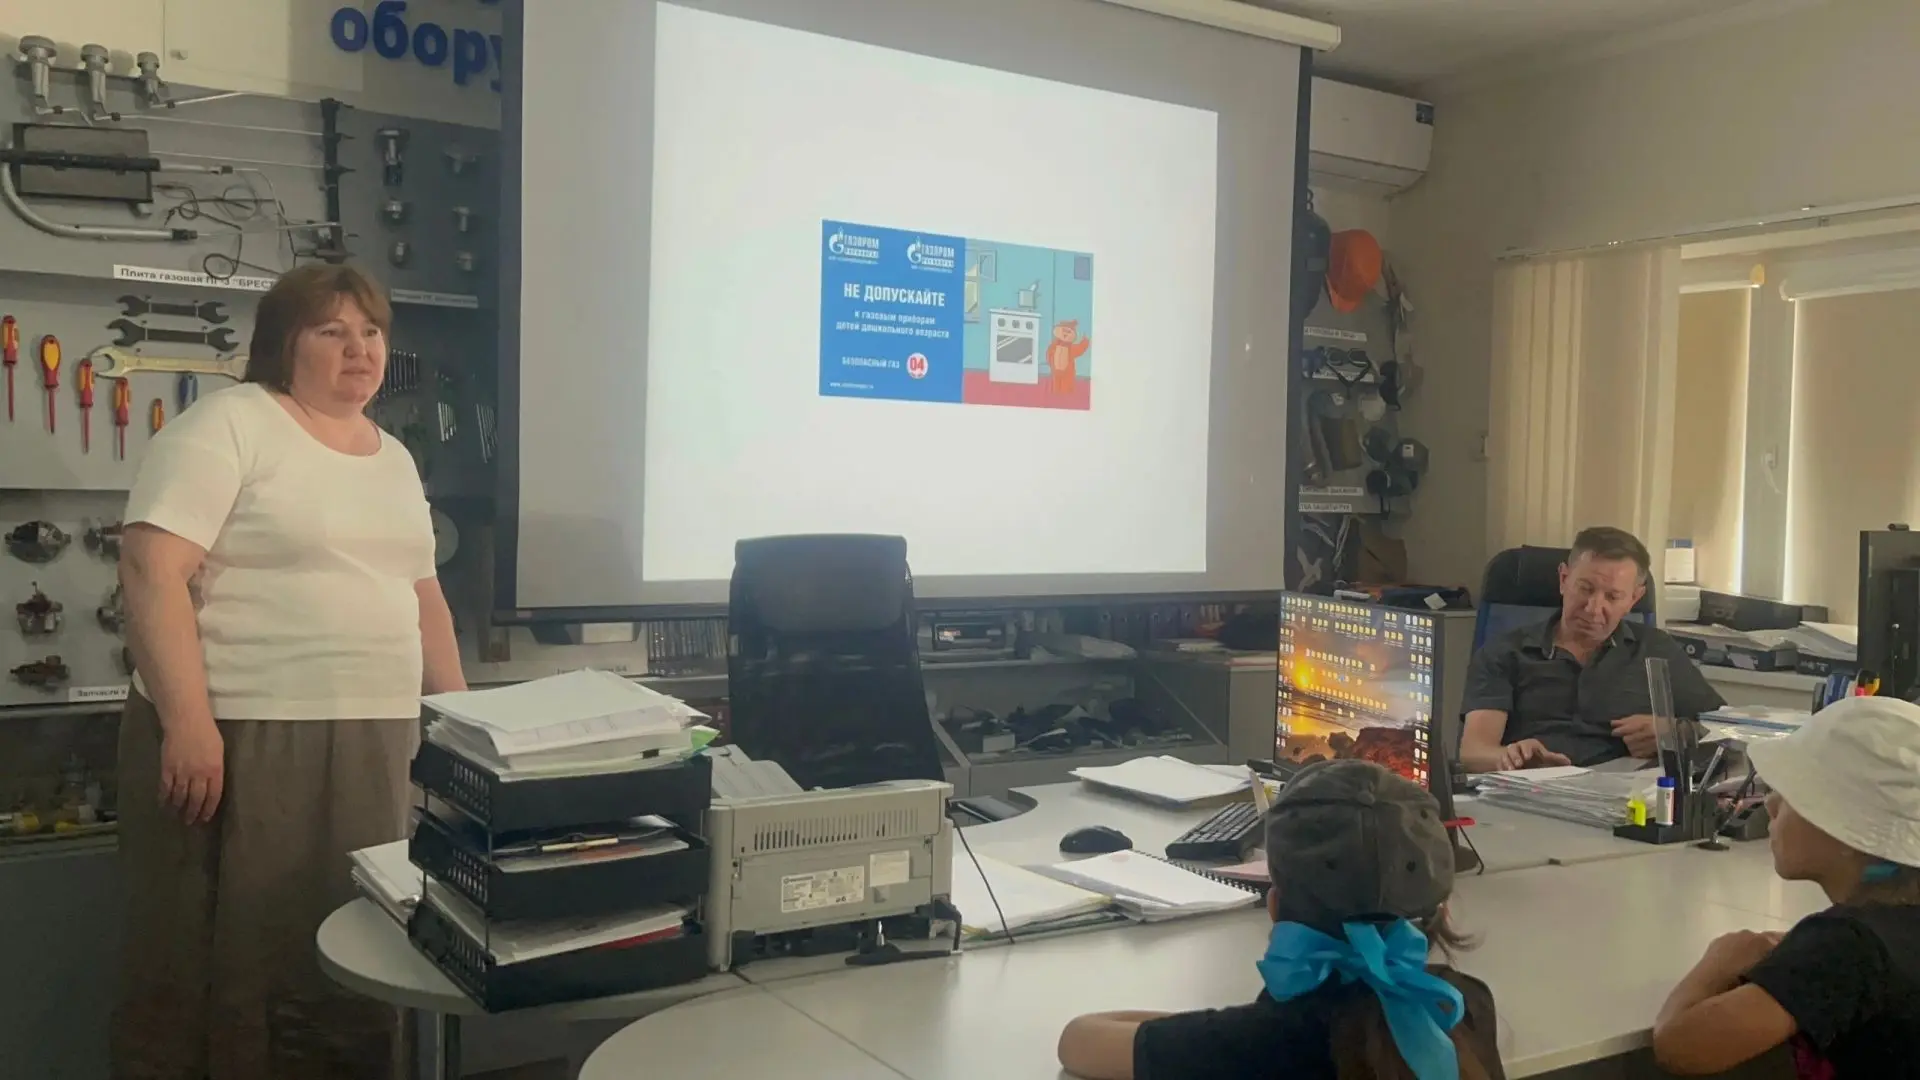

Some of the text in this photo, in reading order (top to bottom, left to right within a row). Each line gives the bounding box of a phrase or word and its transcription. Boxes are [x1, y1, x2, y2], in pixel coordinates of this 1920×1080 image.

[844, 234, 880, 250] ГАЗПРОМ
[921, 244, 955, 259] ГАЗПРОМ
[121, 267, 156, 279] Плита
[159, 273, 203, 284] газовая
[843, 282, 945, 307] НЕ ДОПУСКАЙТЕ
[862, 311, 896, 322] газовым
[898, 313, 936, 325] приборам
[836, 321, 950, 339] детей дошкольного возраста
[888, 359, 900, 369] ГАЗ
[909, 357, 925, 372] 04
